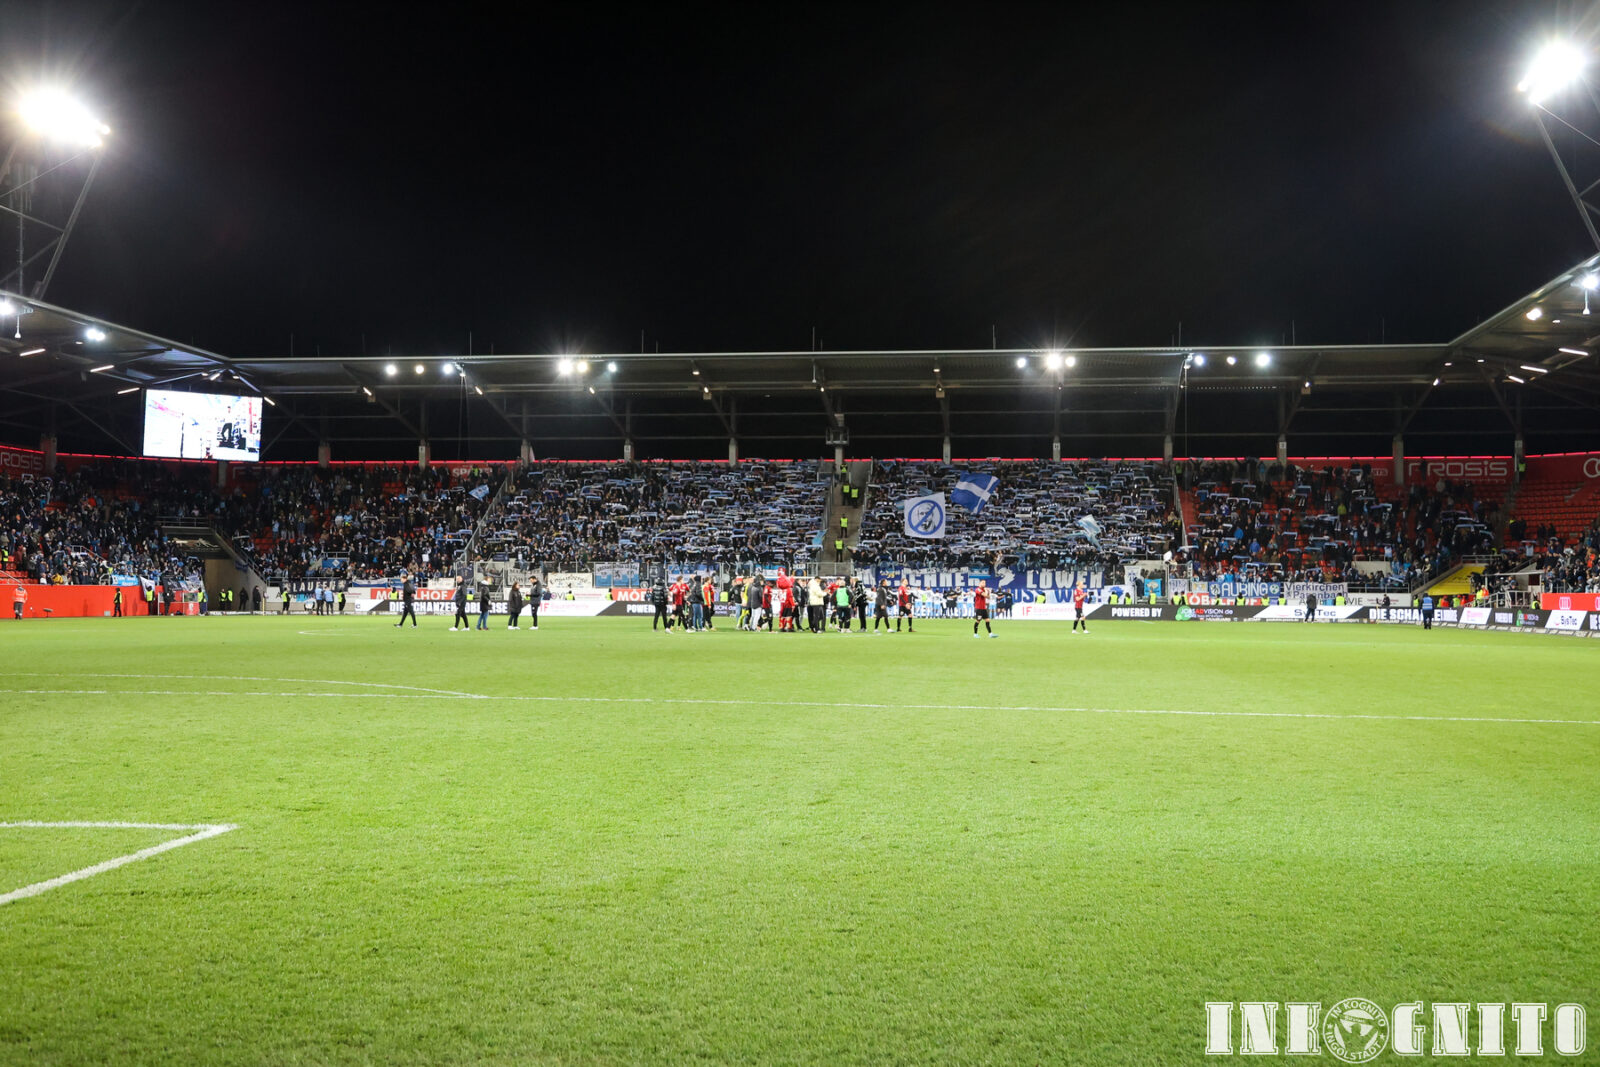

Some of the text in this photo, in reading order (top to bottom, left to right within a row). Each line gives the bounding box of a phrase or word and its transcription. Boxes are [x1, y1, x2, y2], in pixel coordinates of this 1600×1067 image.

[1221, 582, 1268, 597] AUBING
[1285, 582, 1344, 591] Vierkirchen
[412, 602, 457, 613] CHANZER
[1112, 608, 1162, 617] POWERED BY
[1369, 608, 1387, 619] DIE
